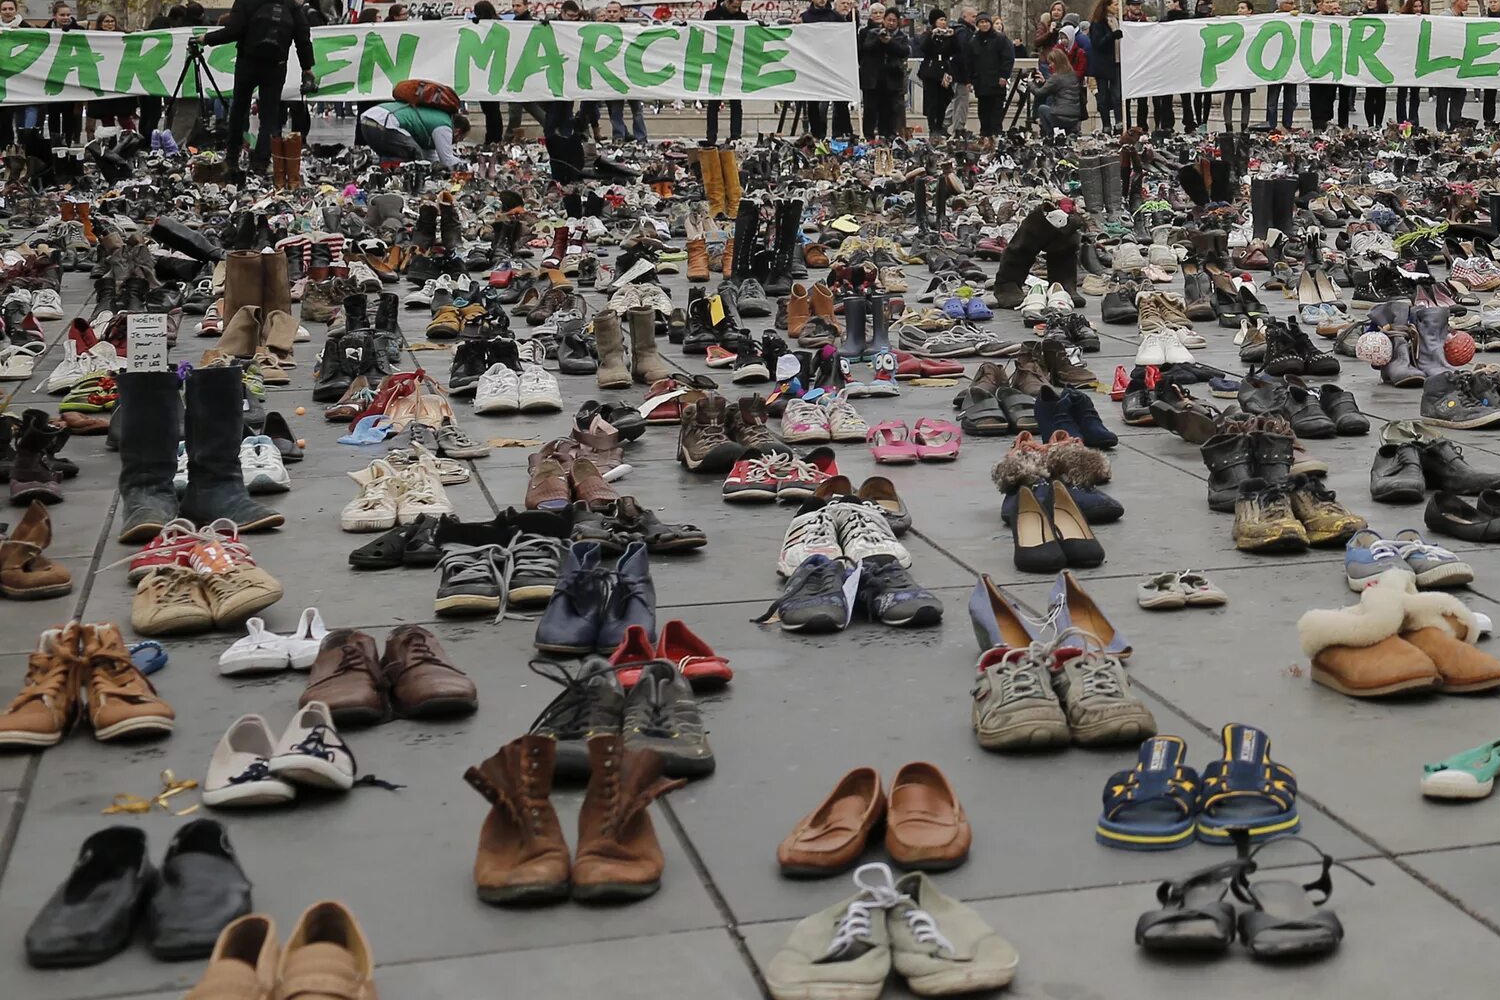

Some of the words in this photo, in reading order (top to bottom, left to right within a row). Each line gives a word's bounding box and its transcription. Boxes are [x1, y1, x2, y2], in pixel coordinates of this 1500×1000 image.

[307, 32, 420, 97] EN
[453, 23, 797, 97] MARCHE
[1199, 17, 1396, 88] POUR
